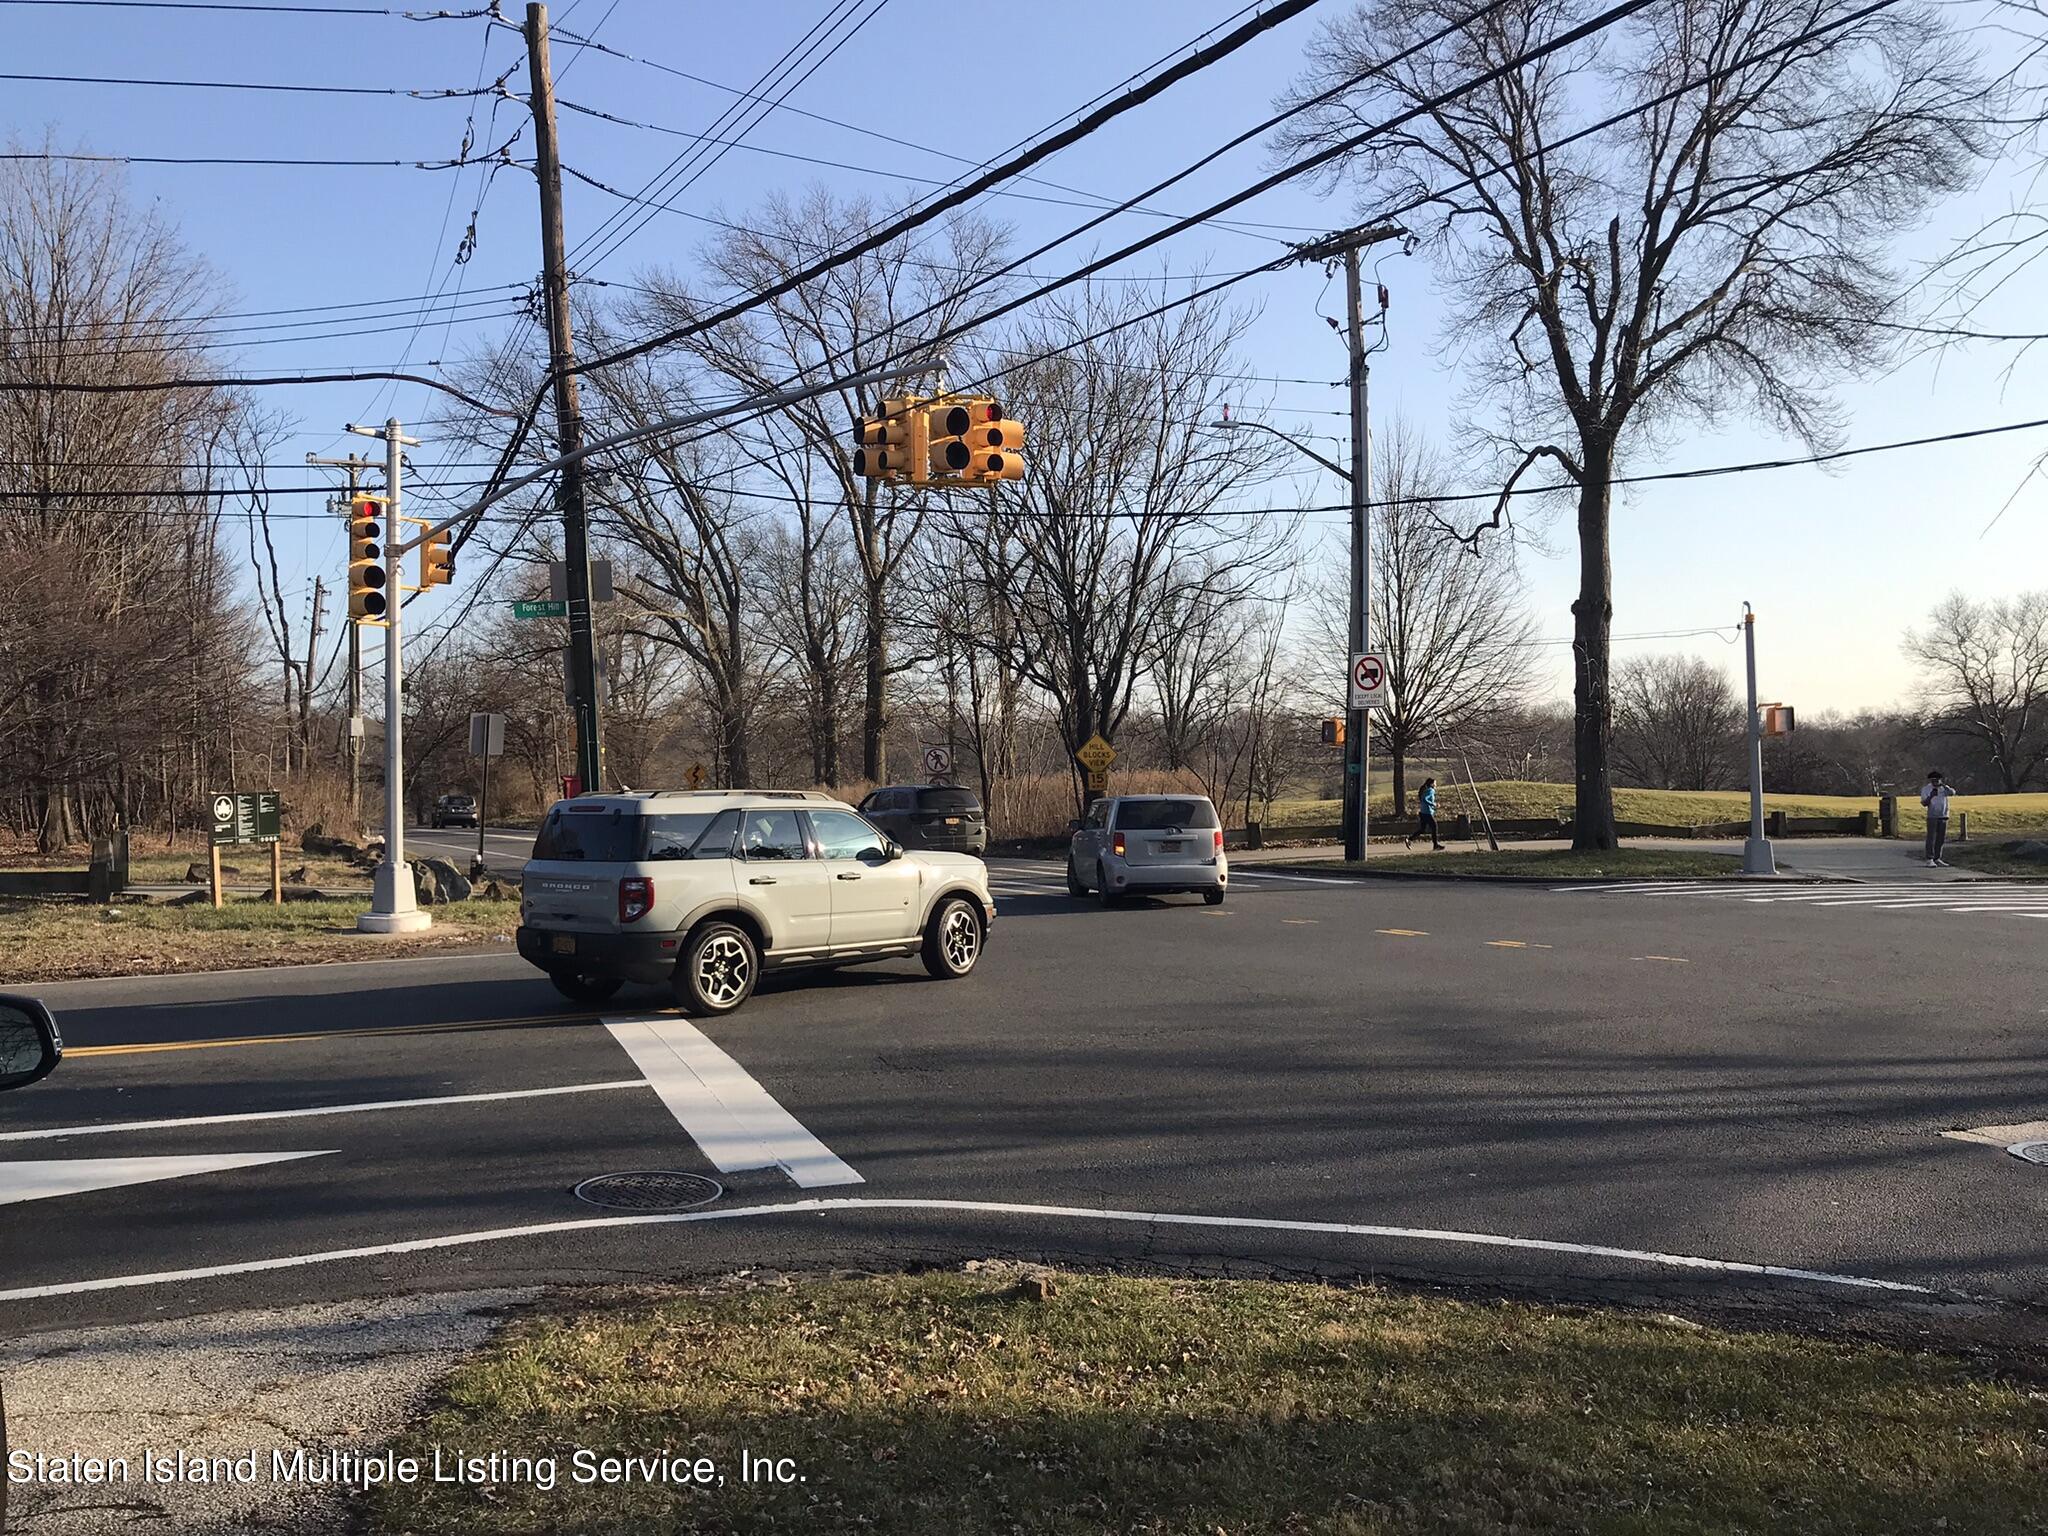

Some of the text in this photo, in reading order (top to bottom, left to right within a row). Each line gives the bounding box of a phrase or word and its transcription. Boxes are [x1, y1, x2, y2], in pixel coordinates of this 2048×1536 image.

[522, 602, 561, 612] Forest Hill
[1083, 751, 1111, 759] BLOCKS
[1091, 773, 1104, 784] 15
[542, 882, 591, 890] BRONCO
